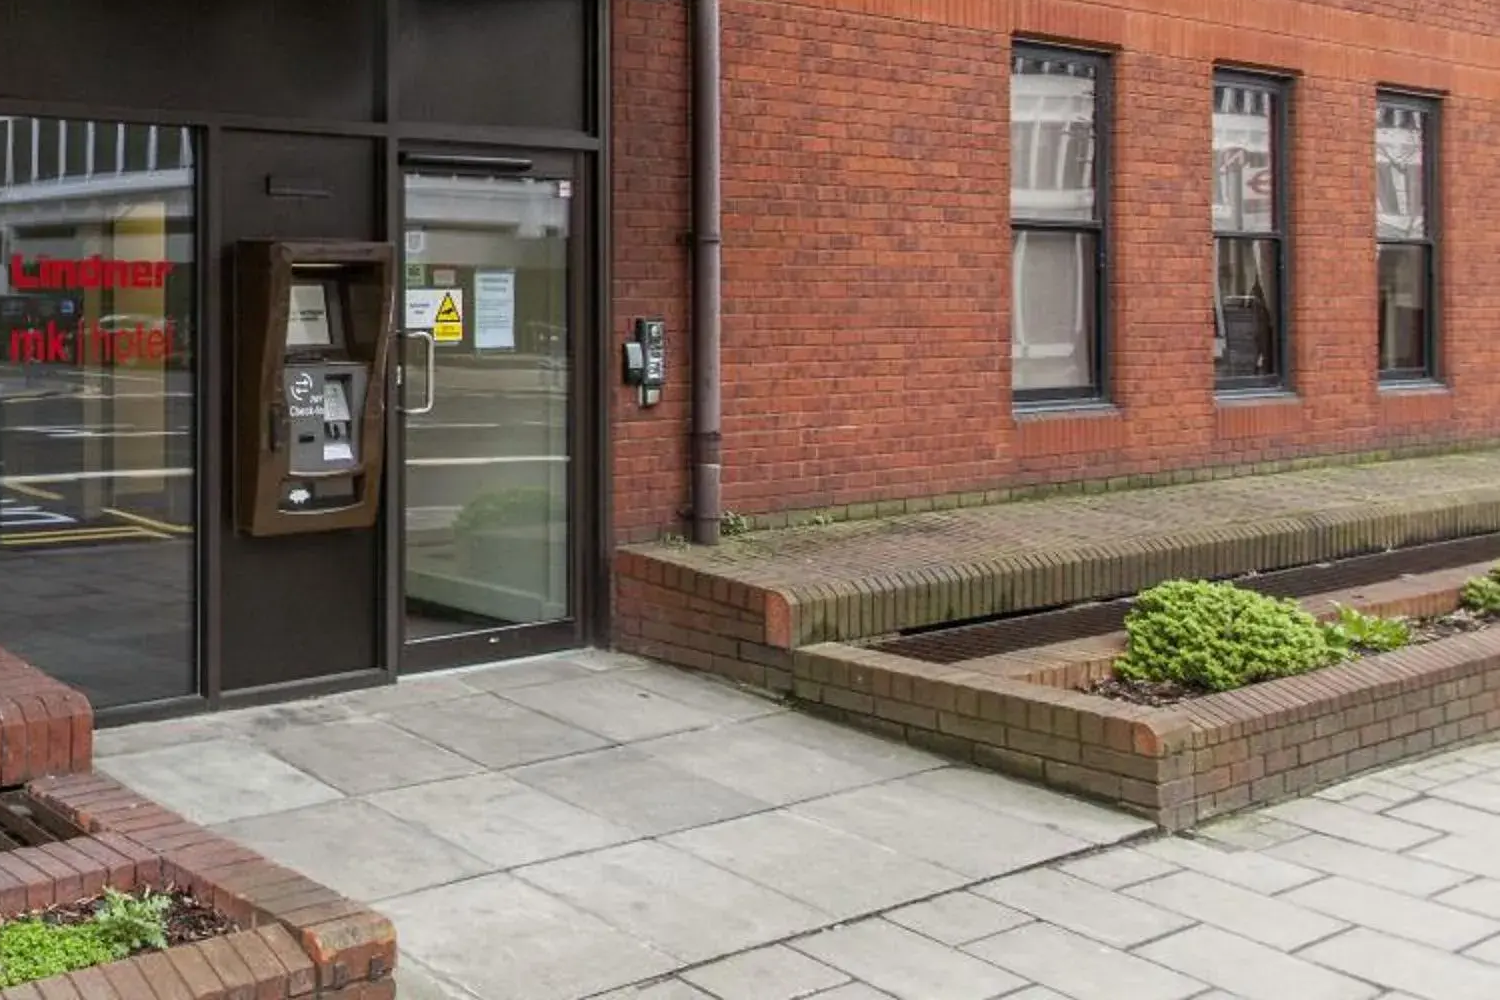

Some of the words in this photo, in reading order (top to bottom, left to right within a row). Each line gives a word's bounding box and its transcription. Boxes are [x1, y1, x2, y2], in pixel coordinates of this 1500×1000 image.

[10, 253, 174, 290] Lindner
[9, 320, 68, 366] mk
[90, 317, 176, 364] hotel
